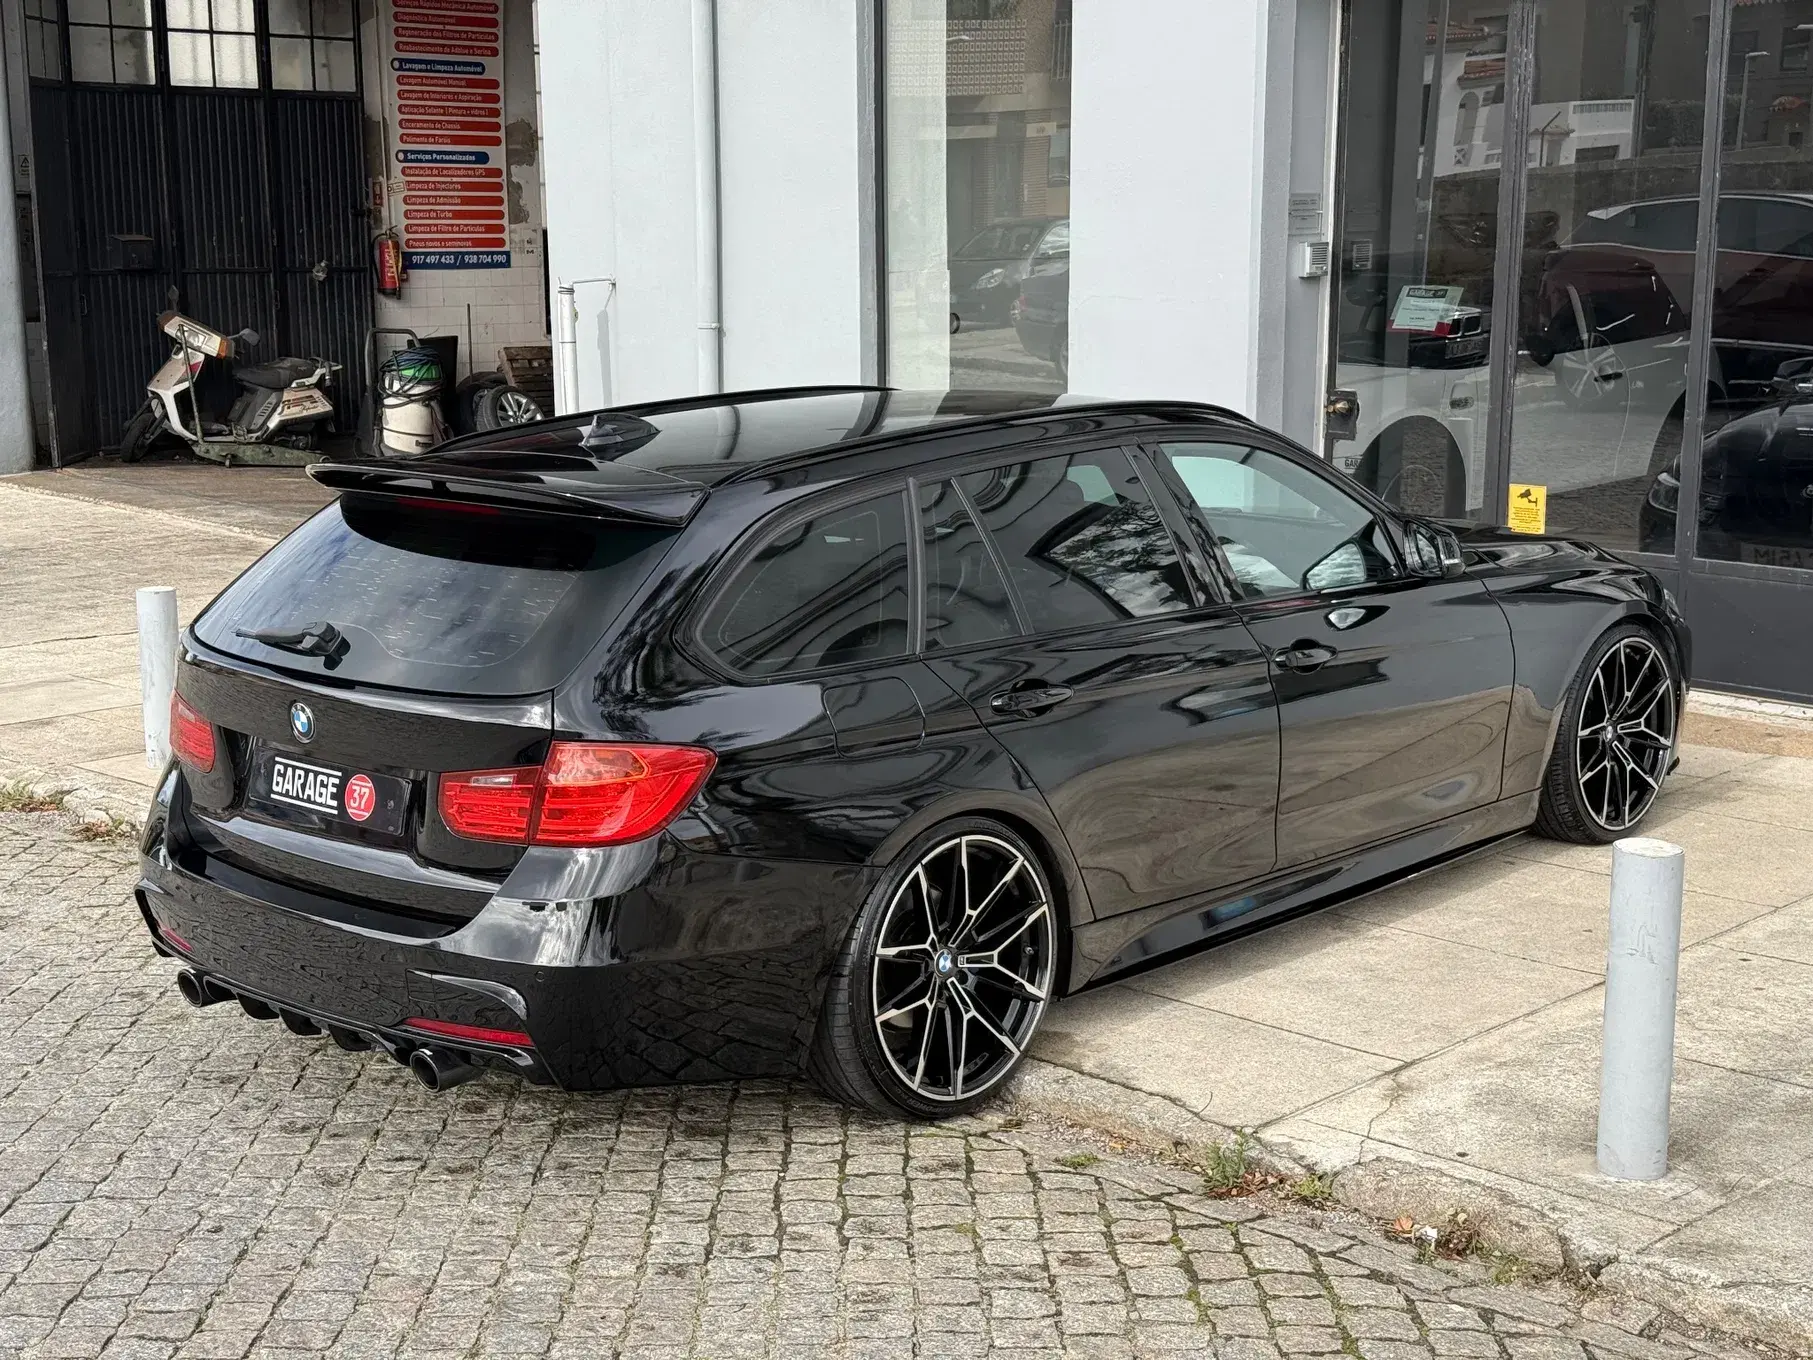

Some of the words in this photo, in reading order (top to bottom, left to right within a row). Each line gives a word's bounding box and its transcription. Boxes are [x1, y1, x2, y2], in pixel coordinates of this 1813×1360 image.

[402, 62, 426, 70] Lavagem
[407, 152, 431, 161] Serviços
[412, 256, 424, 264] 917
[426, 256, 439, 264] 497
[440, 255, 454, 263] 433
[464, 255, 477, 263] 938
[479, 255, 492, 263] 704
[493, 255, 506, 263] 990
[272, 764, 339, 807] GARAGE
[350, 786, 370, 809] 37
